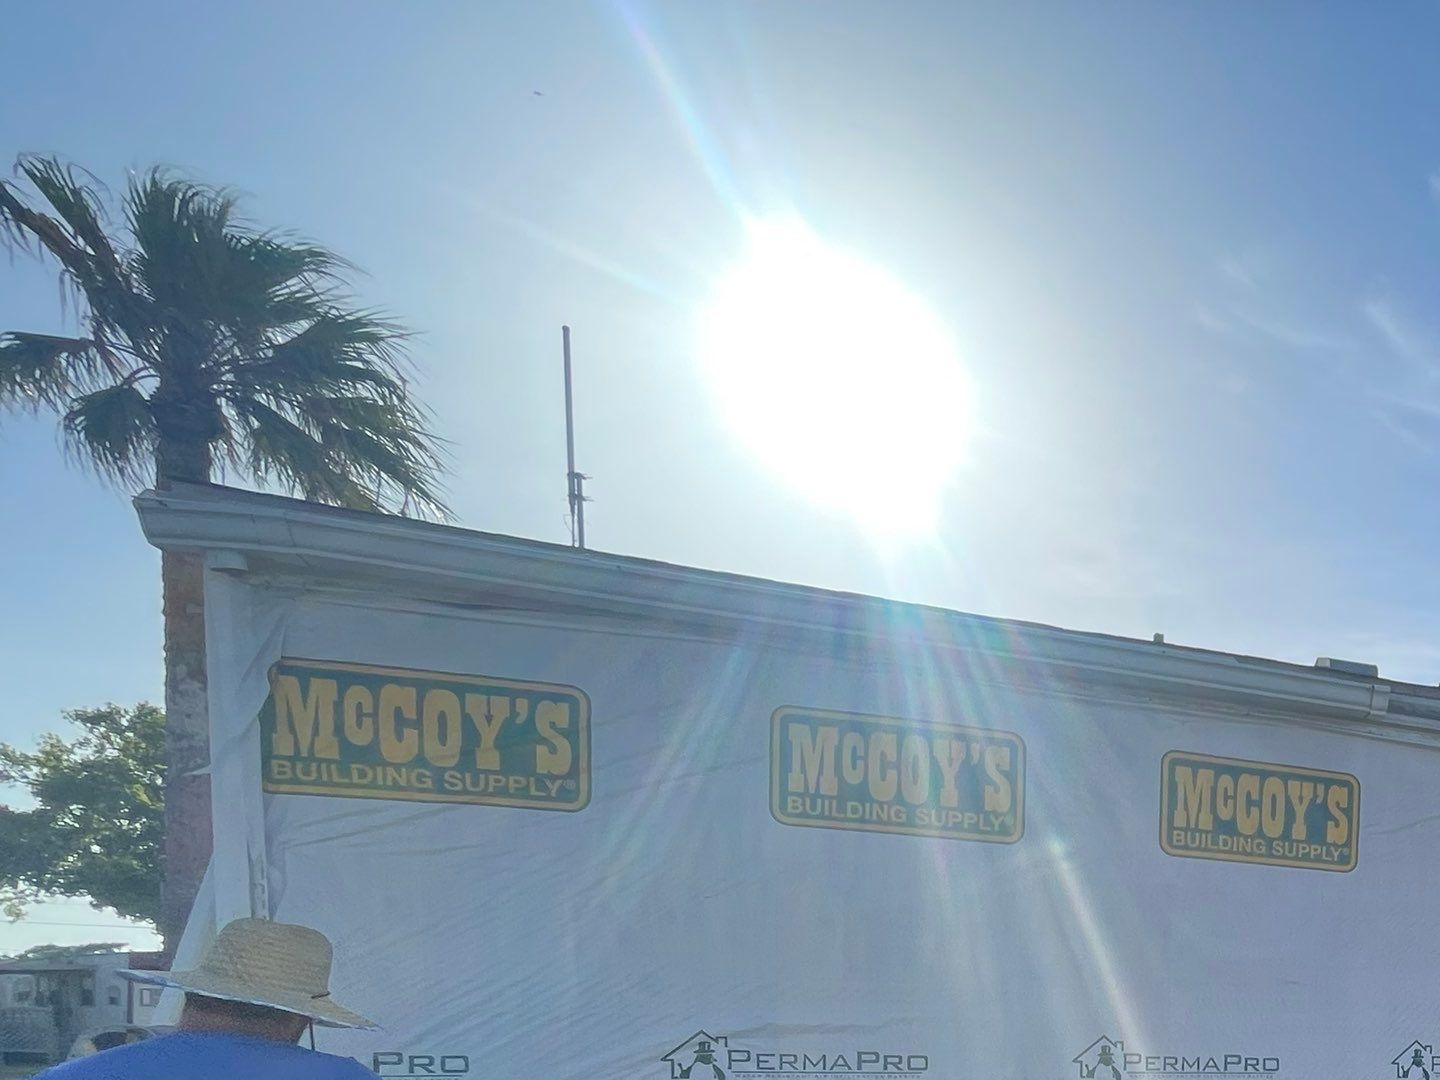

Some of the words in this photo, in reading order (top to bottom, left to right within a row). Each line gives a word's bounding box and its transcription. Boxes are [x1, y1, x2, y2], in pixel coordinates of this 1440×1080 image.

[270, 760, 434, 789] BUILDING
[786, 796, 907, 823] BUILDING
[1172, 830, 1266, 854] BUILDING
[727, 1049, 929, 1071] PERMAPRO
[1123, 1053, 1280, 1072] PERMAPRO
